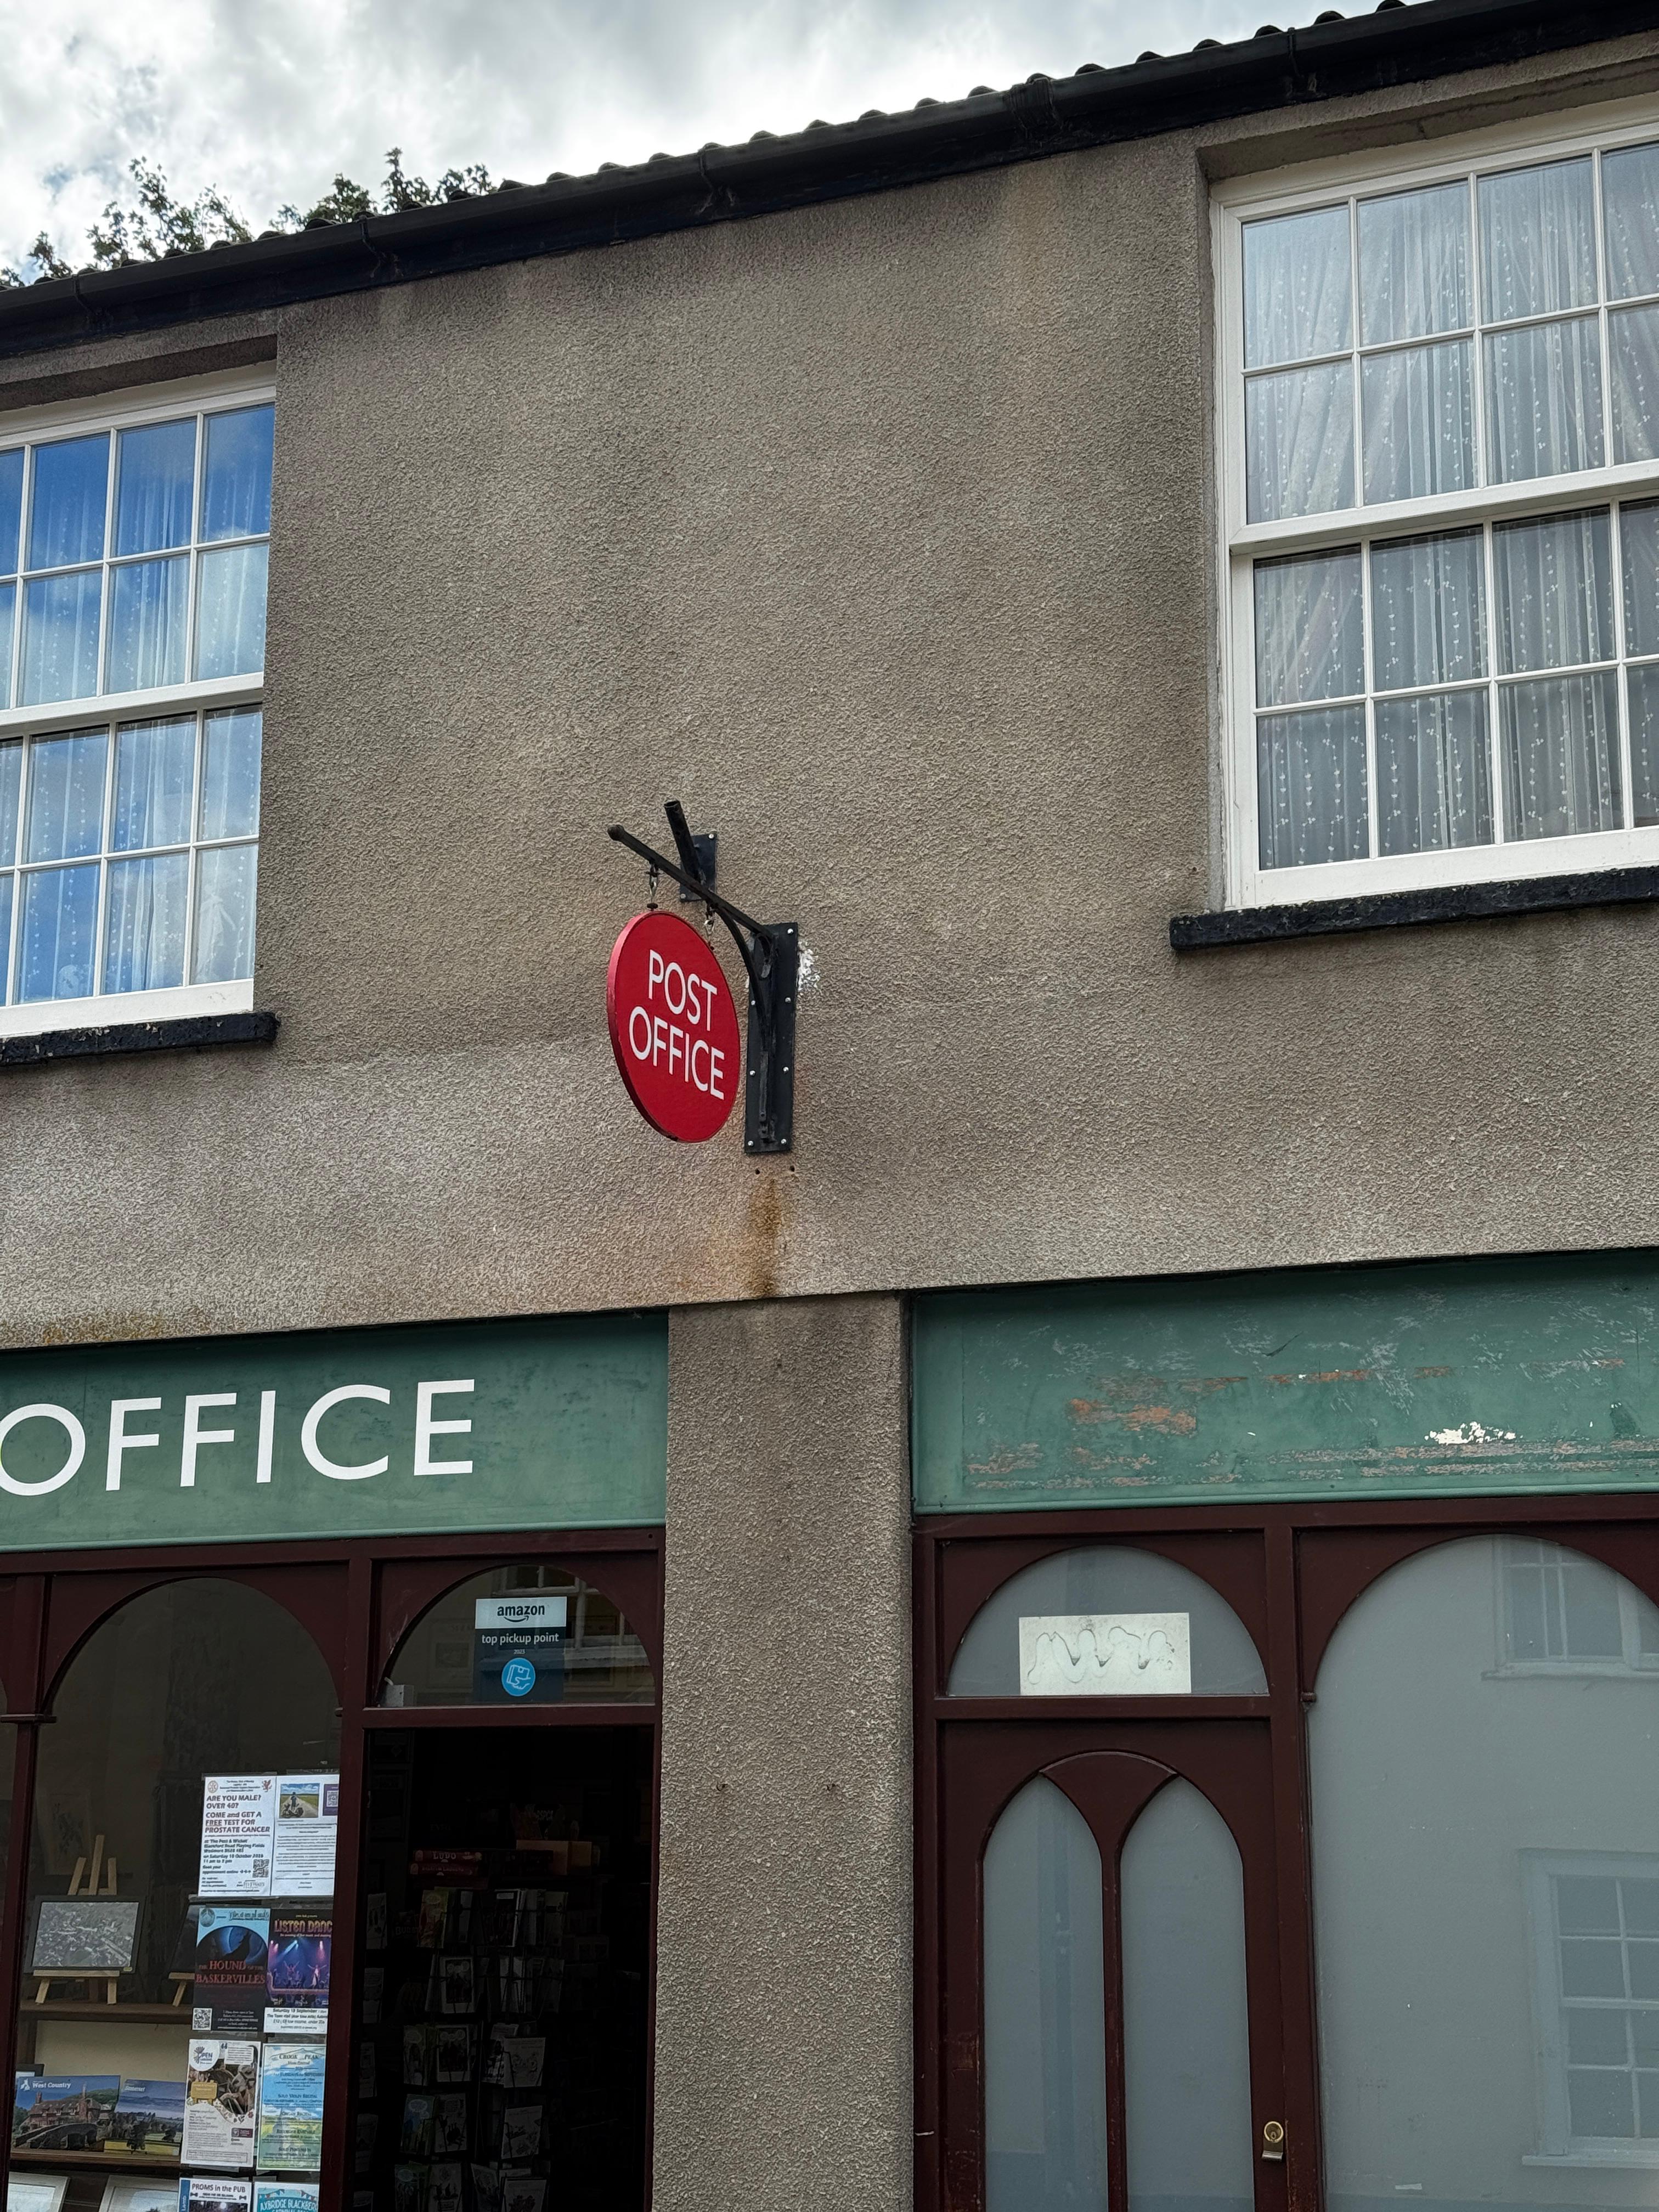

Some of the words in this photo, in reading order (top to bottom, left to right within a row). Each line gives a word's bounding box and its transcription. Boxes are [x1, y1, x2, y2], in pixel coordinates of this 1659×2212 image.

[648, 949, 718, 1031] POST
[629, 1006, 725, 1100] OFFICE
[0, 1379, 475, 1497] OFFICE
[497, 1605, 545, 1617] amazon
[482, 1634, 498, 1645] top
[499, 1633, 532, 1645] pickup
[533, 1632, 560, 1645] point
[432, 1852, 456, 1860] LUDO
[274, 1920, 306, 1932] LISTEN
[210, 1961, 246, 1970] HOUND
[196, 1974, 265, 1984] BASKERVILLES
[260, 2199, 287, 2211] AXBRIDGE
